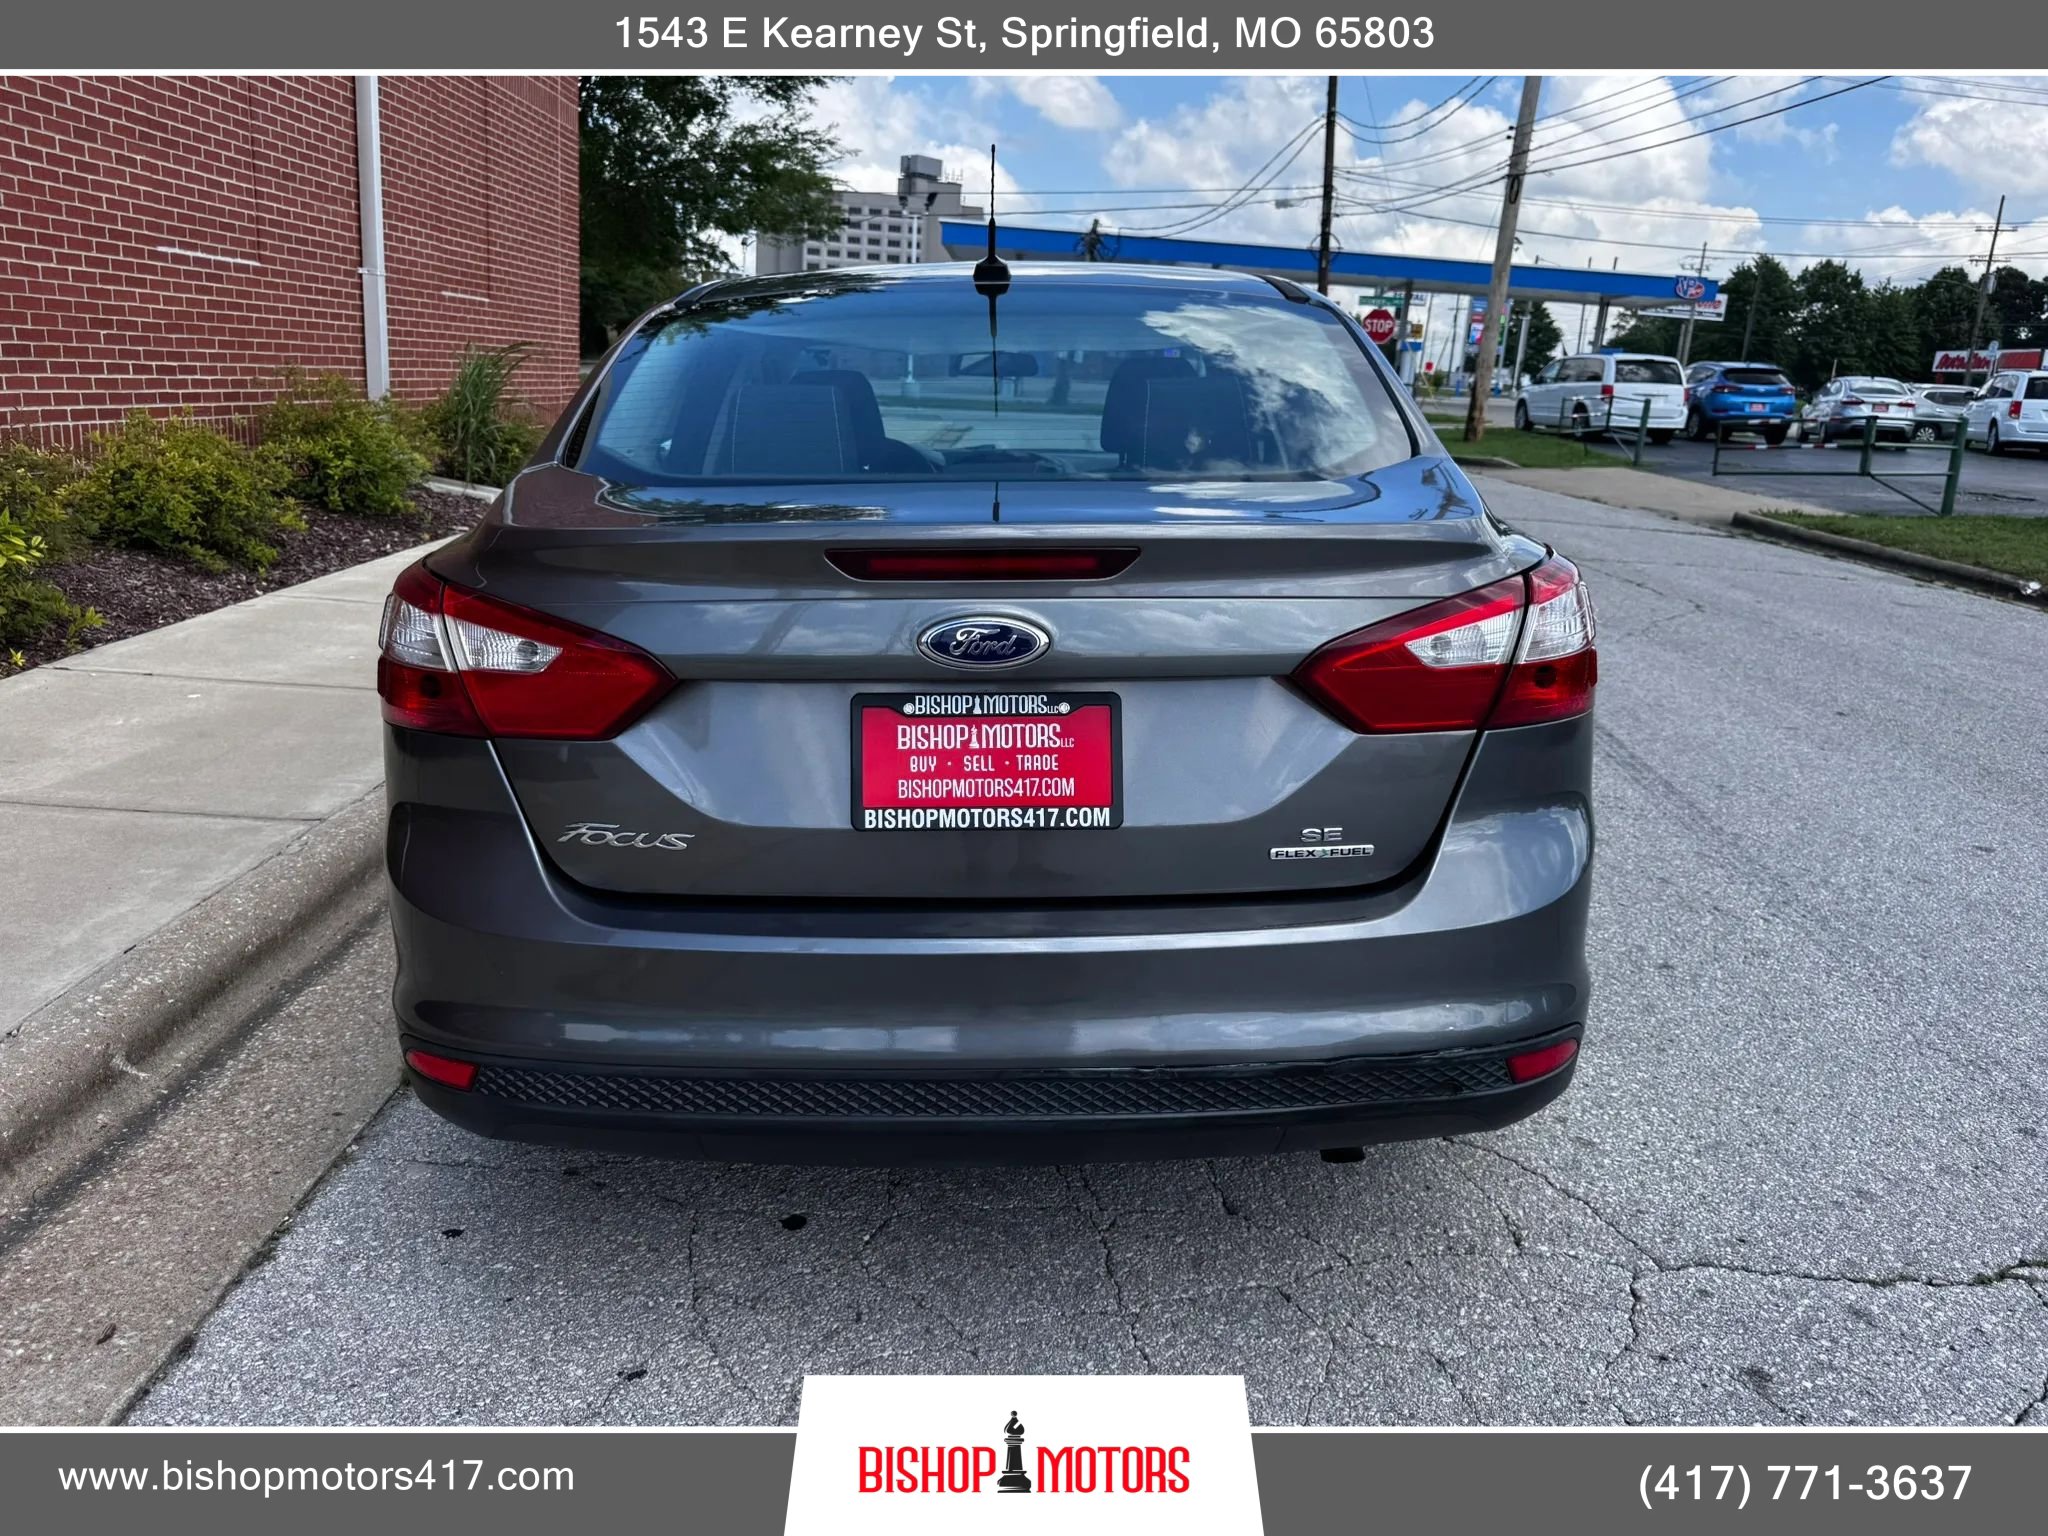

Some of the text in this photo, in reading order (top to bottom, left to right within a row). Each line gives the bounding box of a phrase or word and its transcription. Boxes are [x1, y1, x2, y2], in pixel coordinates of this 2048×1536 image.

[1365, 319, 1394, 333] STOP
[949, 627, 1017, 656] Ford
[915, 694, 1059, 714] BISHOP MOTORS LLC
[897, 723, 1075, 749] BISHOP MOTORS LLC
[910, 754, 1059, 772] BUY SELL TRADE
[898, 777, 1075, 799] BISHOPMOTORS417.COM
[864, 807, 1110, 829] BISHOPMOTORS417.COM
[1301, 827, 1343, 842] SE
[1275, 847, 1371, 858] FLEX FUEL
